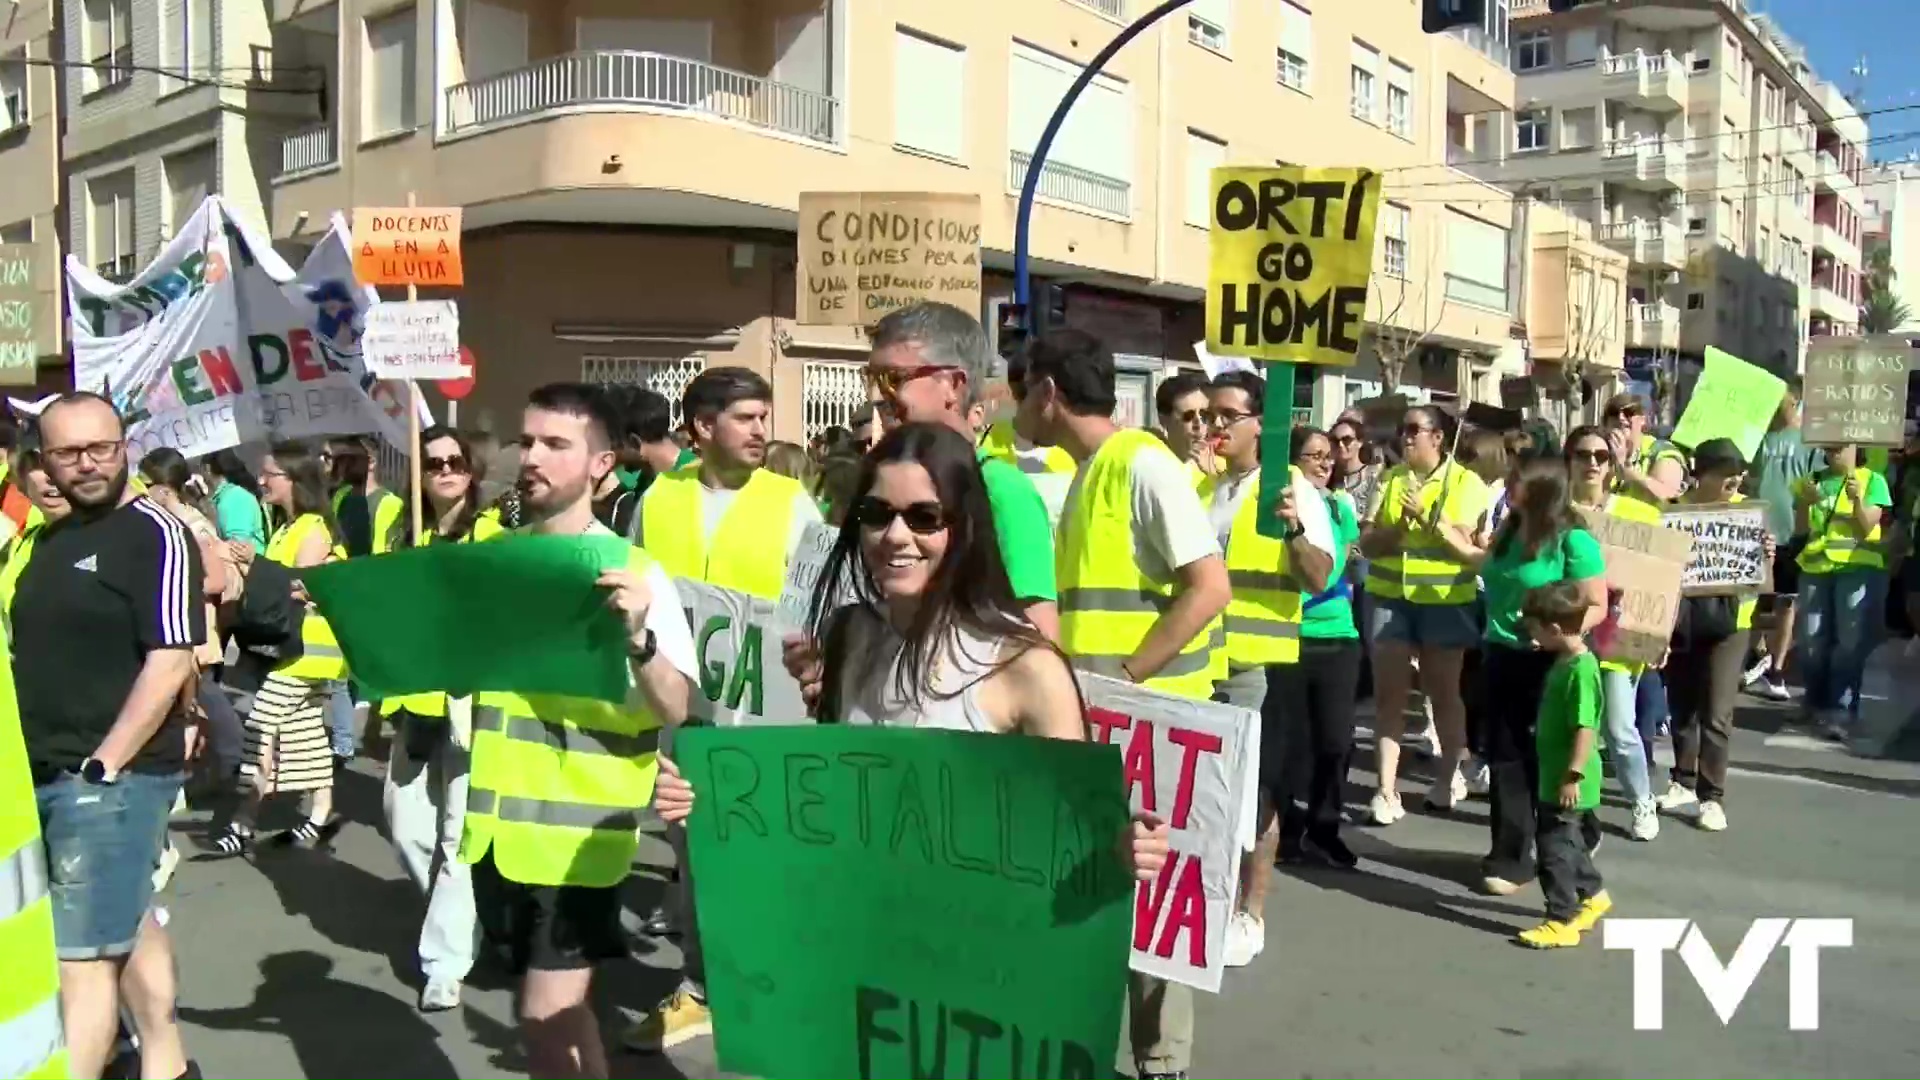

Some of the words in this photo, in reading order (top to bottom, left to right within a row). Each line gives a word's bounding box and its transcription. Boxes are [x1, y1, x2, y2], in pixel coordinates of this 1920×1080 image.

[1216, 171, 1373, 241] ORTÍ
[816, 210, 981, 246] CONDICIONS
[394, 239, 419, 255] EN
[821, 248, 911, 267] DIGNES
[924, 249, 959, 266] PER
[382, 260, 447, 280] LLUITA
[1257, 242, 1313, 282] GO
[810, 276, 848, 295] UNA
[819, 296, 847, 311] DE
[1220, 283, 1368, 354] HOME
[684, 606, 764, 717] GA
